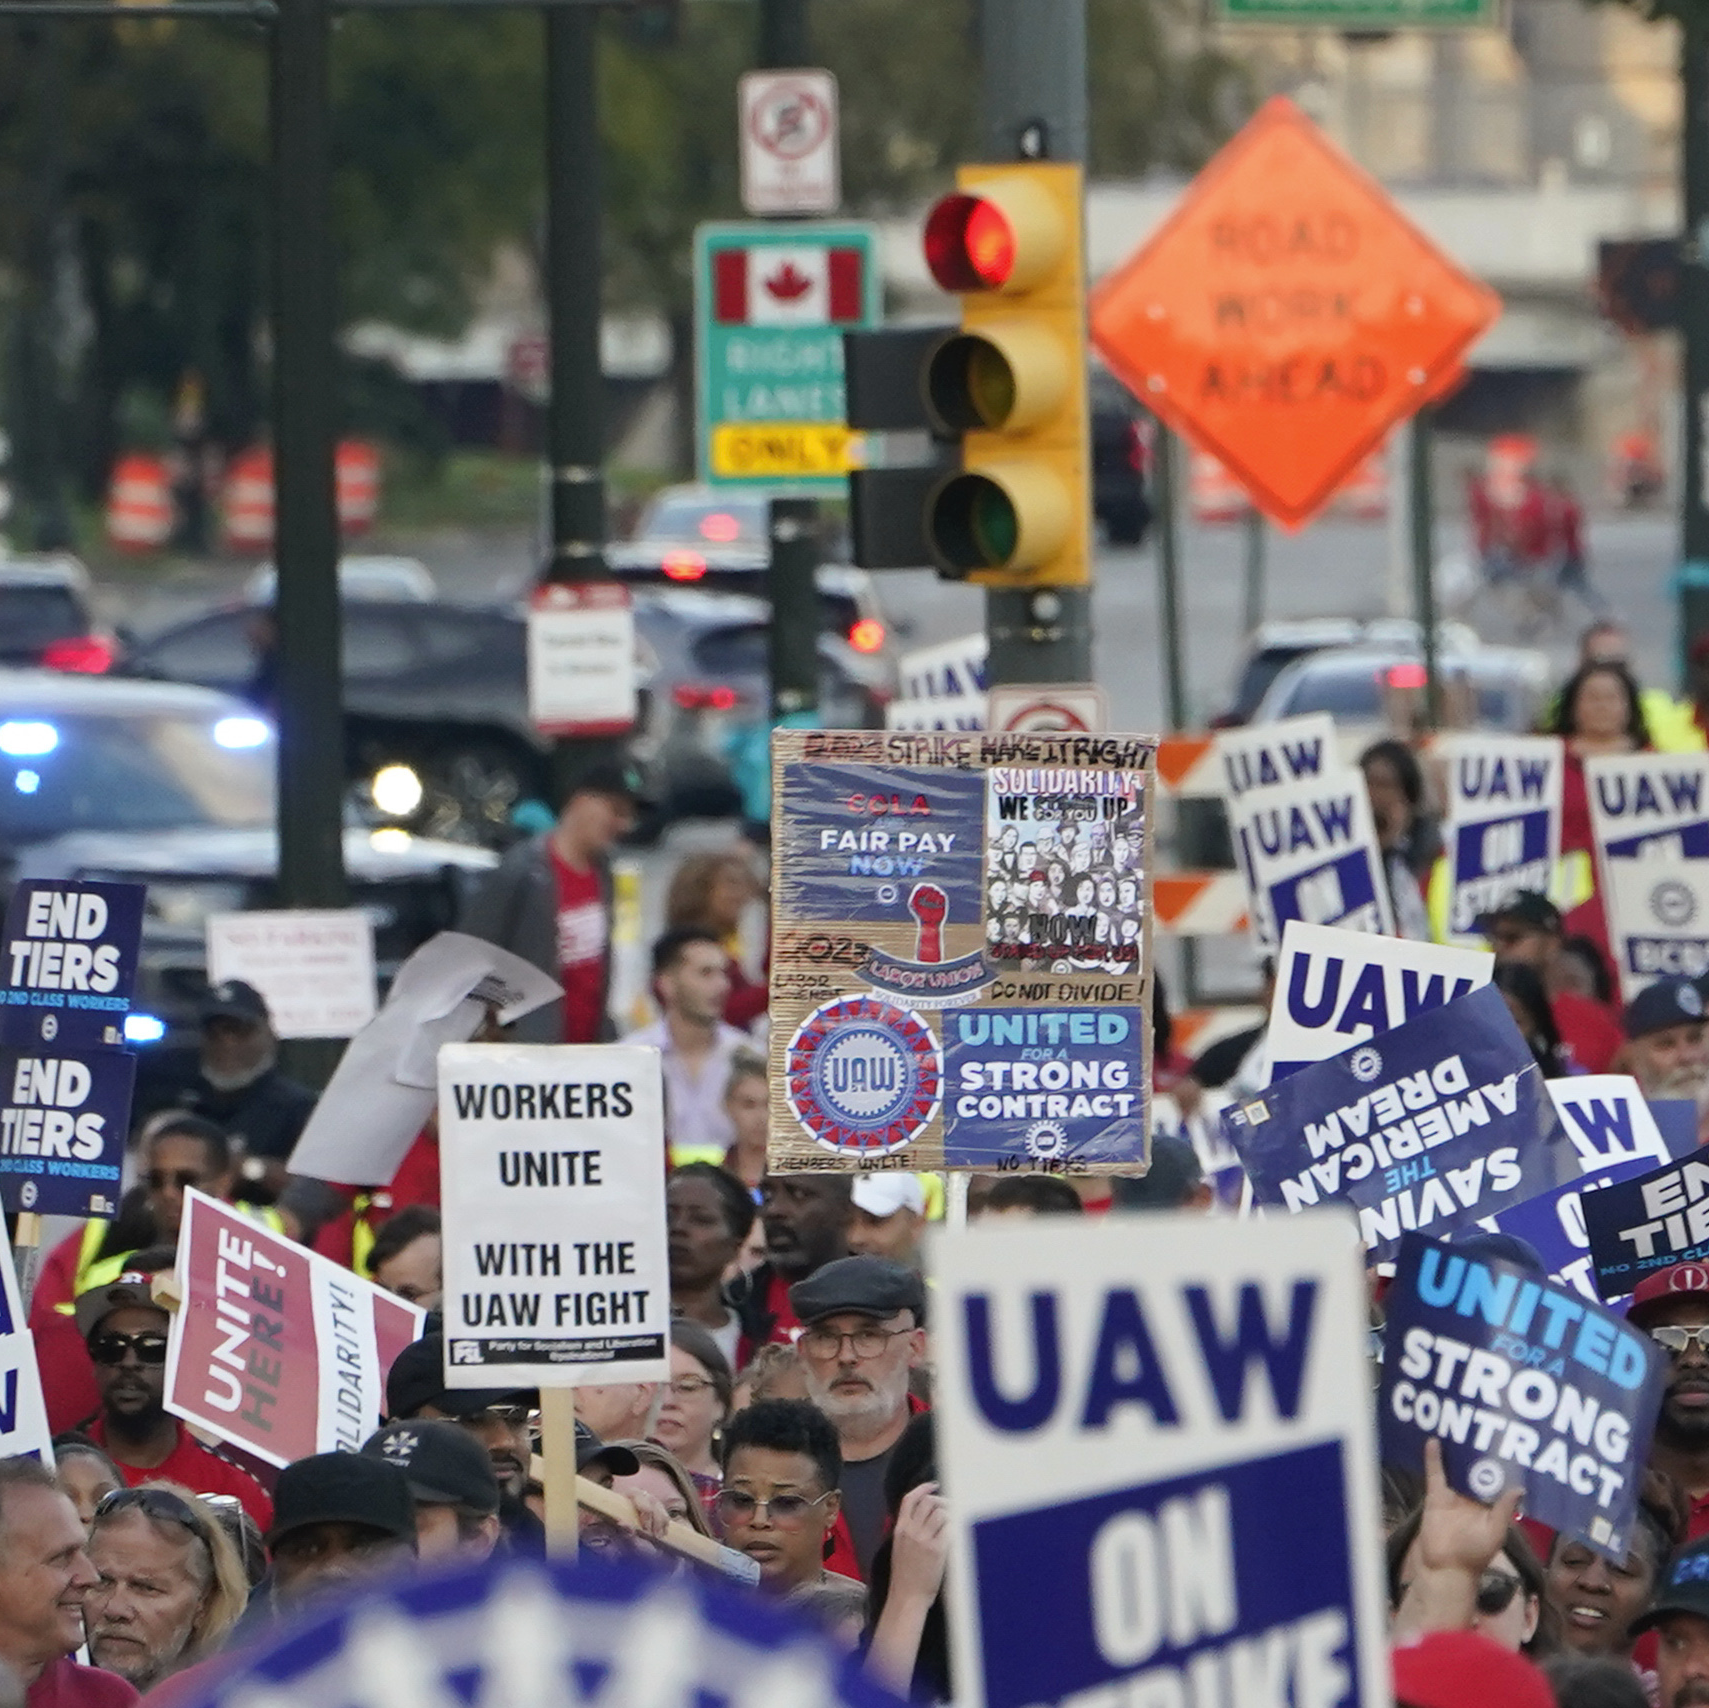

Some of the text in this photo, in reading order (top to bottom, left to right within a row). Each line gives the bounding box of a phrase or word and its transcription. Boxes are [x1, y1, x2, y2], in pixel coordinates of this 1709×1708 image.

[1211, 216, 1358, 267] ROAD
[1216, 289, 1355, 331] WORK
[1201, 357, 1387, 405] AHEAD
[727, 429, 848, 470] ONLY
[993, 767, 1135, 796] SOLIDARITY
[1224, 737, 1323, 798] UAW
[1459, 755, 1552, 801] UAW
[846, 792, 932, 817] COLA
[997, 795, 1029, 822] WE
[1102, 796, 1129, 821] UP
[1596, 771, 1703, 818] UAW
[820, 829, 957, 853] FAIR PAY
[1253, 793, 1353, 860] UAW
[849, 854, 927, 877] NOW
[25, 889, 109, 941] END
[10, 940, 122, 993] TIERS
[927, 960, 987, 989] UNION
[30, 992, 64, 1008] CLASS
[67, 993, 131, 1012] WORKERS
[991, 981, 1016, 1000] DO
[1018, 981, 1055, 1001] NOT
[958, 1012, 1130, 1047] UNITED
[1019, 1047, 1069, 1061] FOR A
[11, 1057, 92, 1108] END
[831, 1056, 896, 1095] UAW
[960, 1060, 1130, 1092] STRONG
[452, 1080, 634, 1121] WORKERS
[956, 1094, 1136, 1120] CONTRACT
[1302, 1055, 1472, 1160] DREAM
[0, 1107, 107, 1161] TIERS
[1278, 1072, 1521, 1216] AMERICAN
[47, 1161, 121, 1182] WORKERS
[498, 1149, 603, 1188] UNITE
[996, 1156, 1021, 1172] NO
[1384, 1154, 1438, 1194] THE
[1357, 1147, 1524, 1249] SAVIN
[473, 1241, 637, 1277] WITH THE
[1599, 1263, 1631, 1277] NO
[1636, 1253, 1678, 1271] 2ND
[203, 1227, 253, 1413] UNITE
[461, 1289, 651, 1328] UAW FIGHT
[1417, 1247, 1648, 1391] UNITED
[240, 1250, 287, 1433] HERE!
[487, 1340, 517, 1353] Party
[517, 1340, 533, 1351] for
[584, 1338, 605, 1350] and
[605, 1336, 658, 1350] Liberation
[960, 1275, 1323, 1440] UAW
[1548, 1356, 1566, 1378] A
[1399, 1325, 1631, 1464] STRONG
[1391, 1380, 1625, 1509] CONTRACT
[1089, 1483, 1240, 1670] ON
